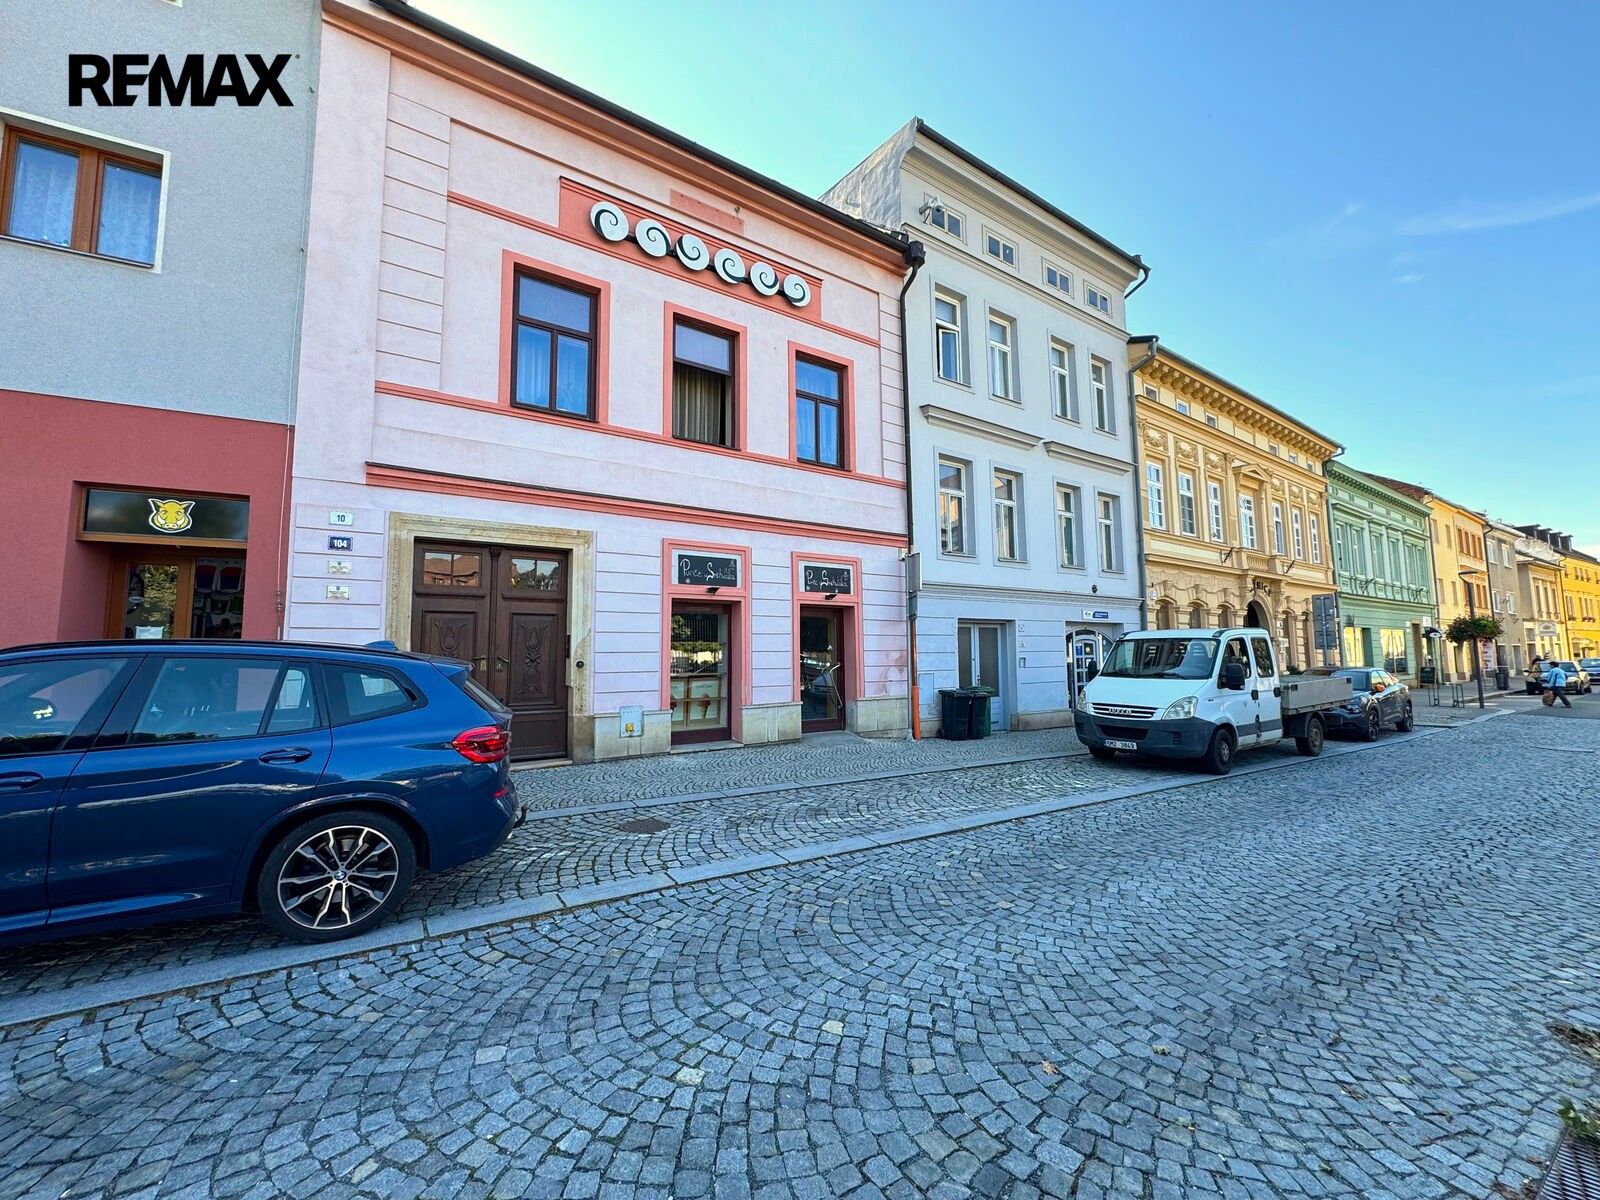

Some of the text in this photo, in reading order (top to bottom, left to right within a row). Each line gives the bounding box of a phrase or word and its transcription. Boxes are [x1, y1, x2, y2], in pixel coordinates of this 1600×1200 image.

[336, 514, 346, 523] 10
[333, 539, 348, 548] 104
[1109, 707, 1130, 716] IVECO
